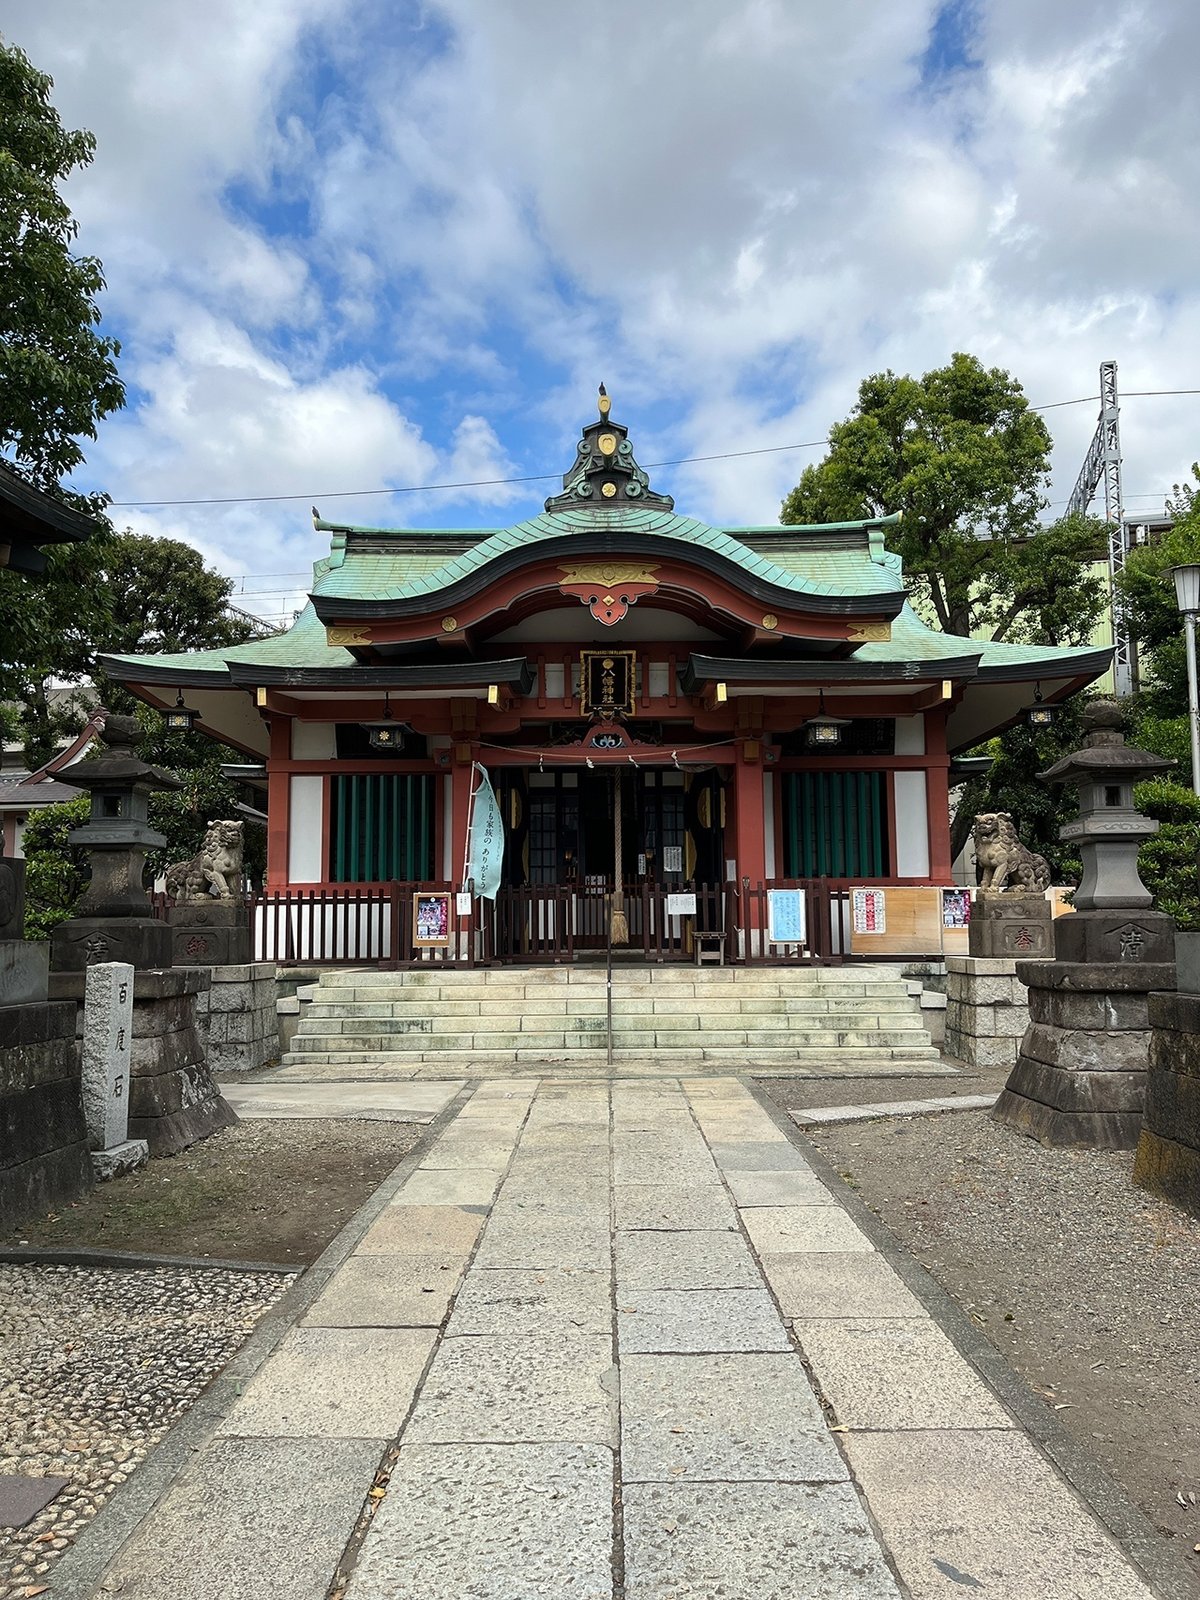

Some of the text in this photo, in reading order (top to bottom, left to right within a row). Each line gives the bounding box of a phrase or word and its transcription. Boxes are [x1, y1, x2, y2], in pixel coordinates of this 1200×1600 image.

[601, 670, 616, 704] 八幡神社
[480, 848, 490, 889] ありがとう
[186, 936, 209, 956] 納
[1014, 927, 1035, 950] 奉
[1120, 929, 1144, 957] 清
[112, 982, 128, 1097] 百度石
